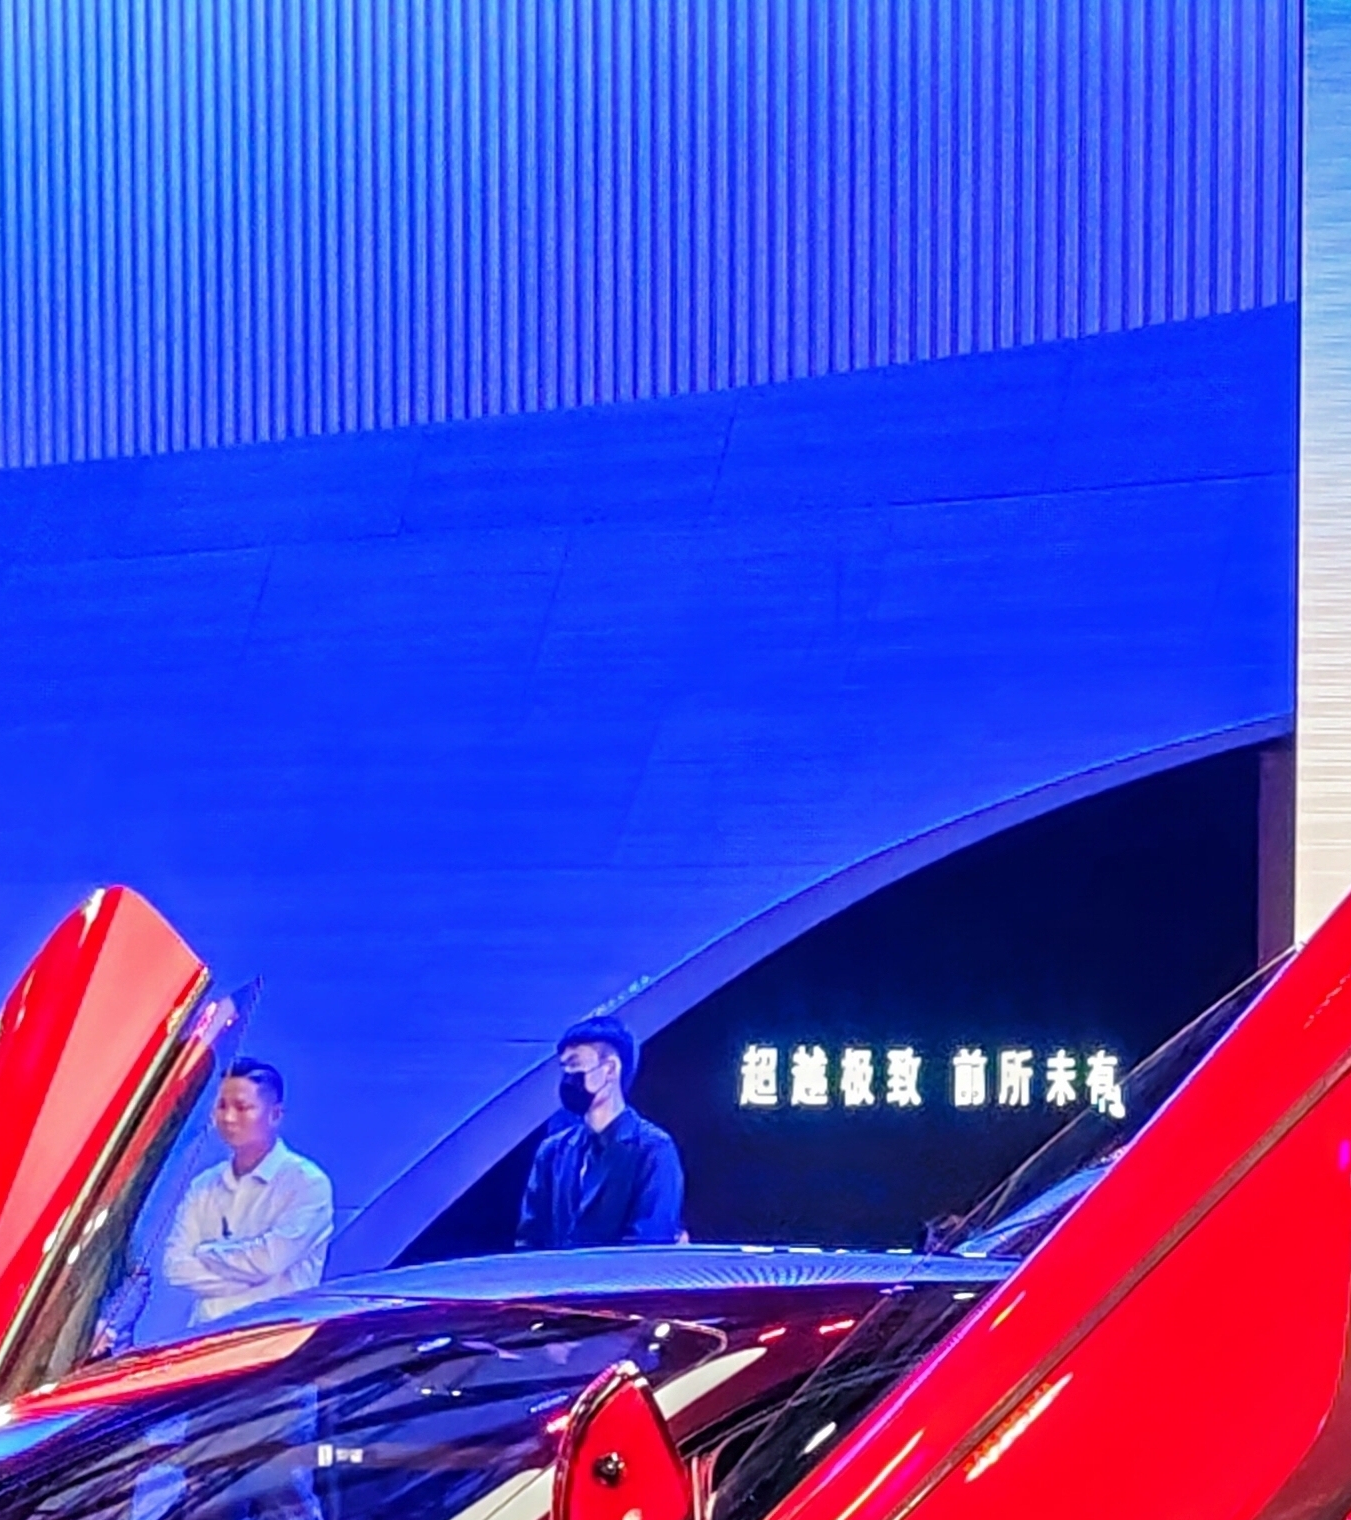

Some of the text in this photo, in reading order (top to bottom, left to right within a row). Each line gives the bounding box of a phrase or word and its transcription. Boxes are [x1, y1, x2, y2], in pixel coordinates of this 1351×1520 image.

[740, 1044, 1126, 1119] 超越极致 前所未有
